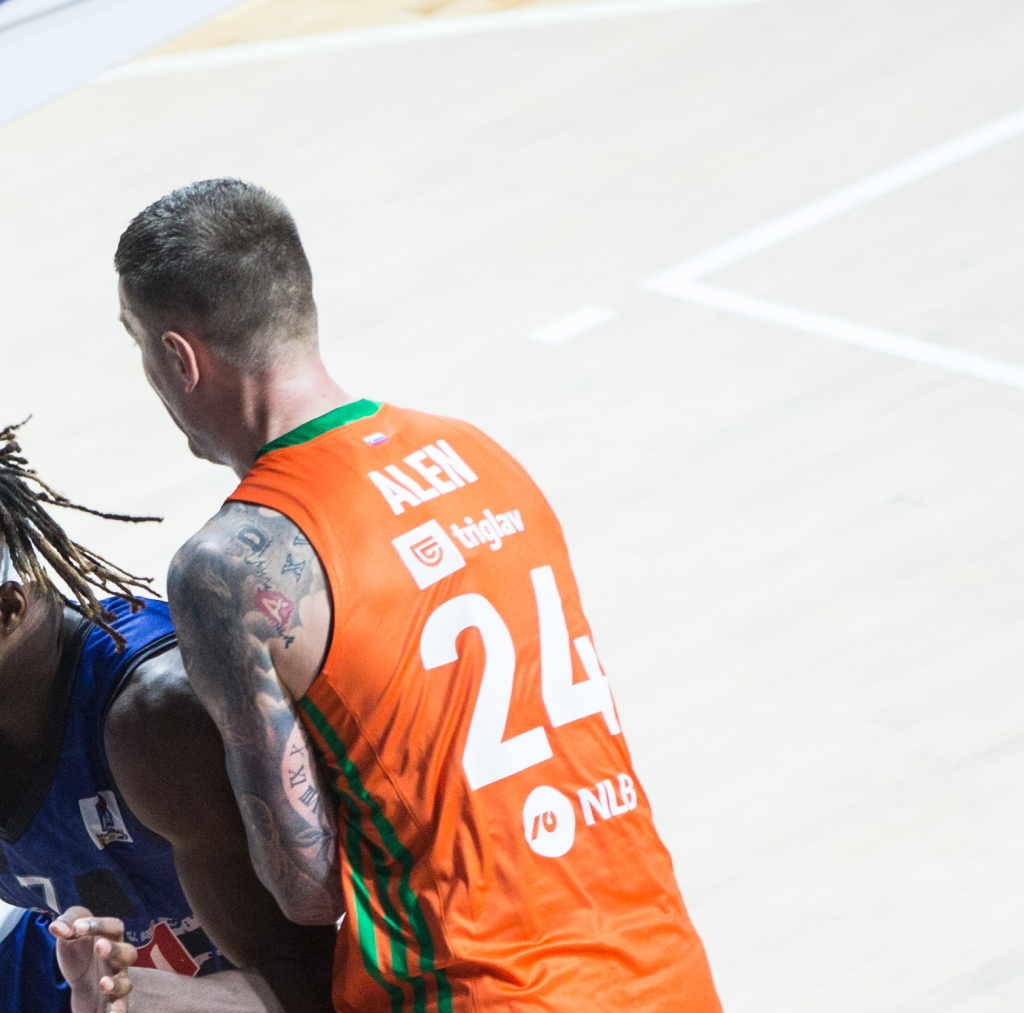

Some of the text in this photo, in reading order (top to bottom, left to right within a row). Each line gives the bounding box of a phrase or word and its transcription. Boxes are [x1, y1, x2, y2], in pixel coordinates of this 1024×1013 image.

[368, 439, 479, 516] ALEN
[450, 508, 525, 552] triglav
[419, 564, 621, 791] 24
[577, 773, 637, 827] NLB
